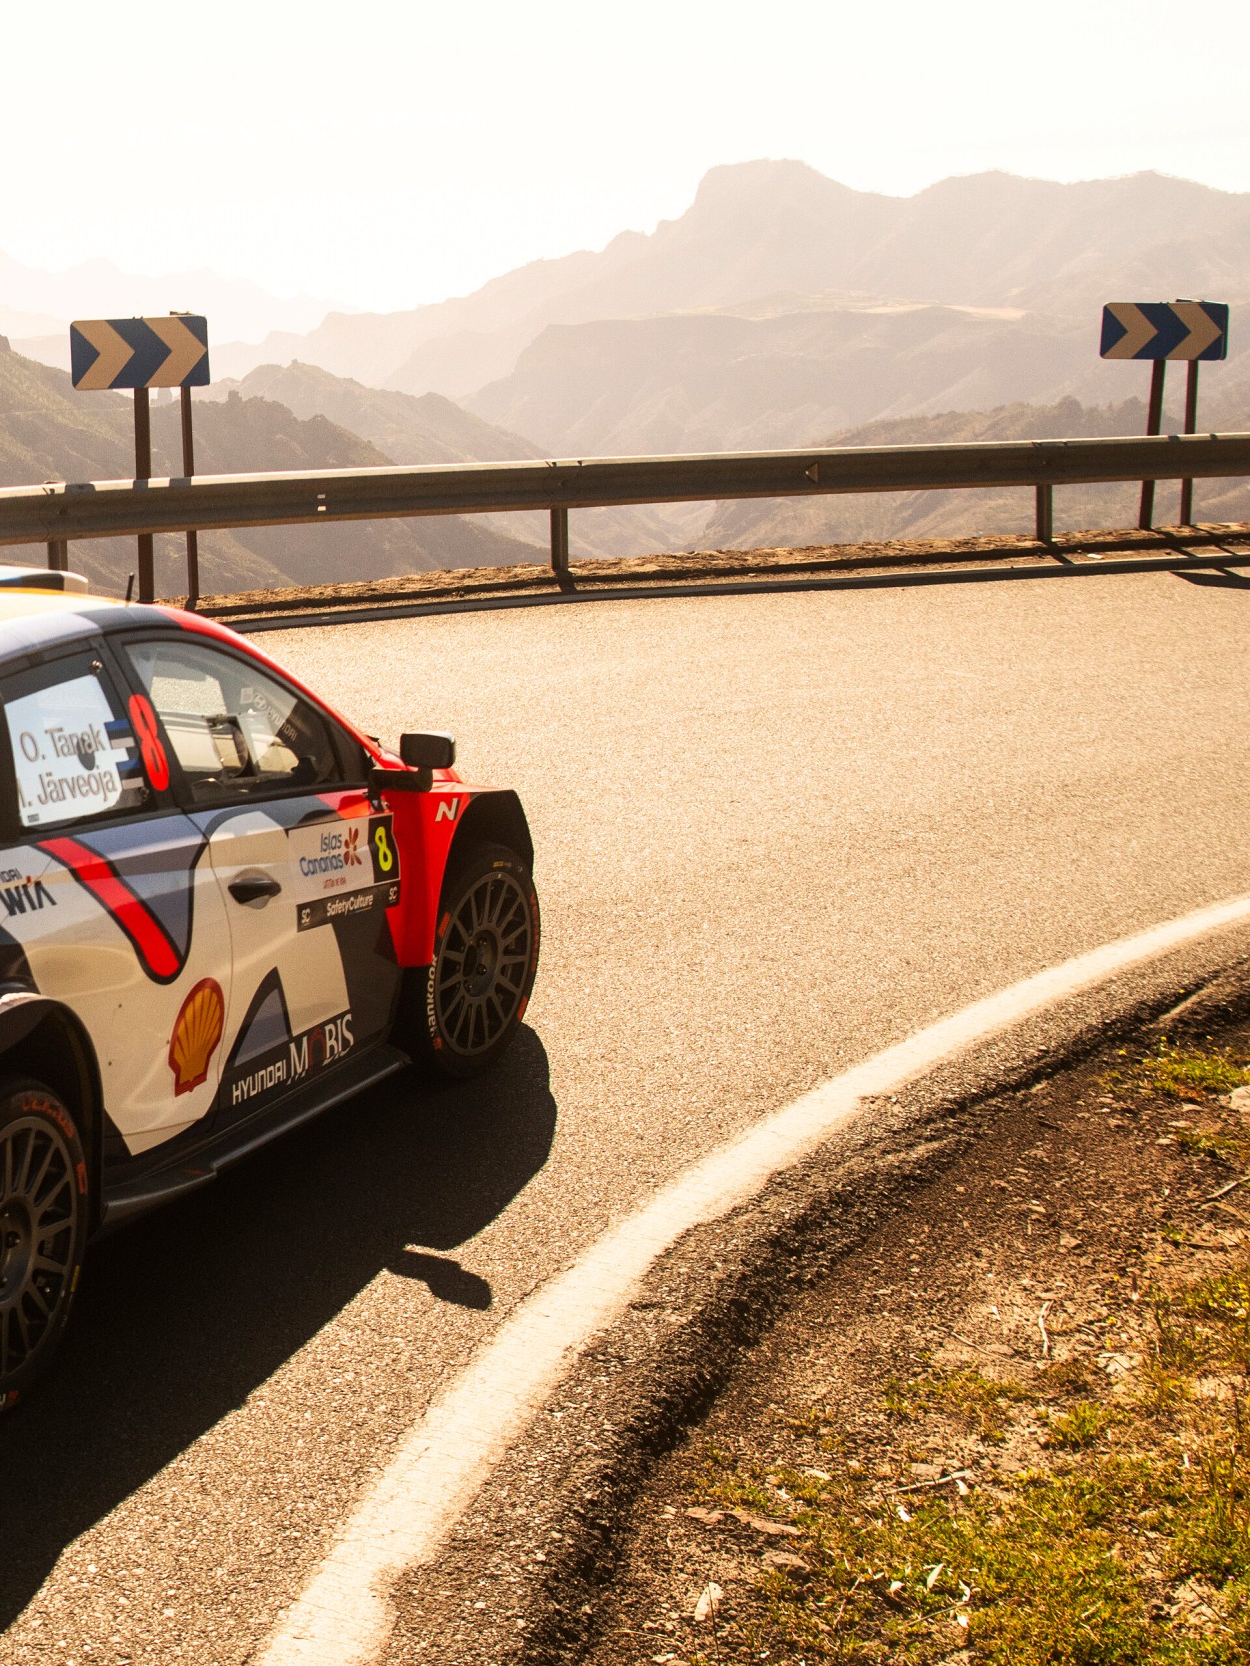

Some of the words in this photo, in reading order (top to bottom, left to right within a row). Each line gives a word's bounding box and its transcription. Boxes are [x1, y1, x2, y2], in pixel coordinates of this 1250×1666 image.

[20, 731, 46, 763] O.
[129, 693, 169, 791] 8
[37, 764, 118, 804] Järveoja
[435, 797, 459, 822] N
[300, 852, 344, 877] Canarias
[320, 831, 343, 853] Islas
[375, 826, 393, 872] 8
[232, 1059, 287, 1106] HYUNDAI
[287, 1013, 354, 1086] MOBIS
